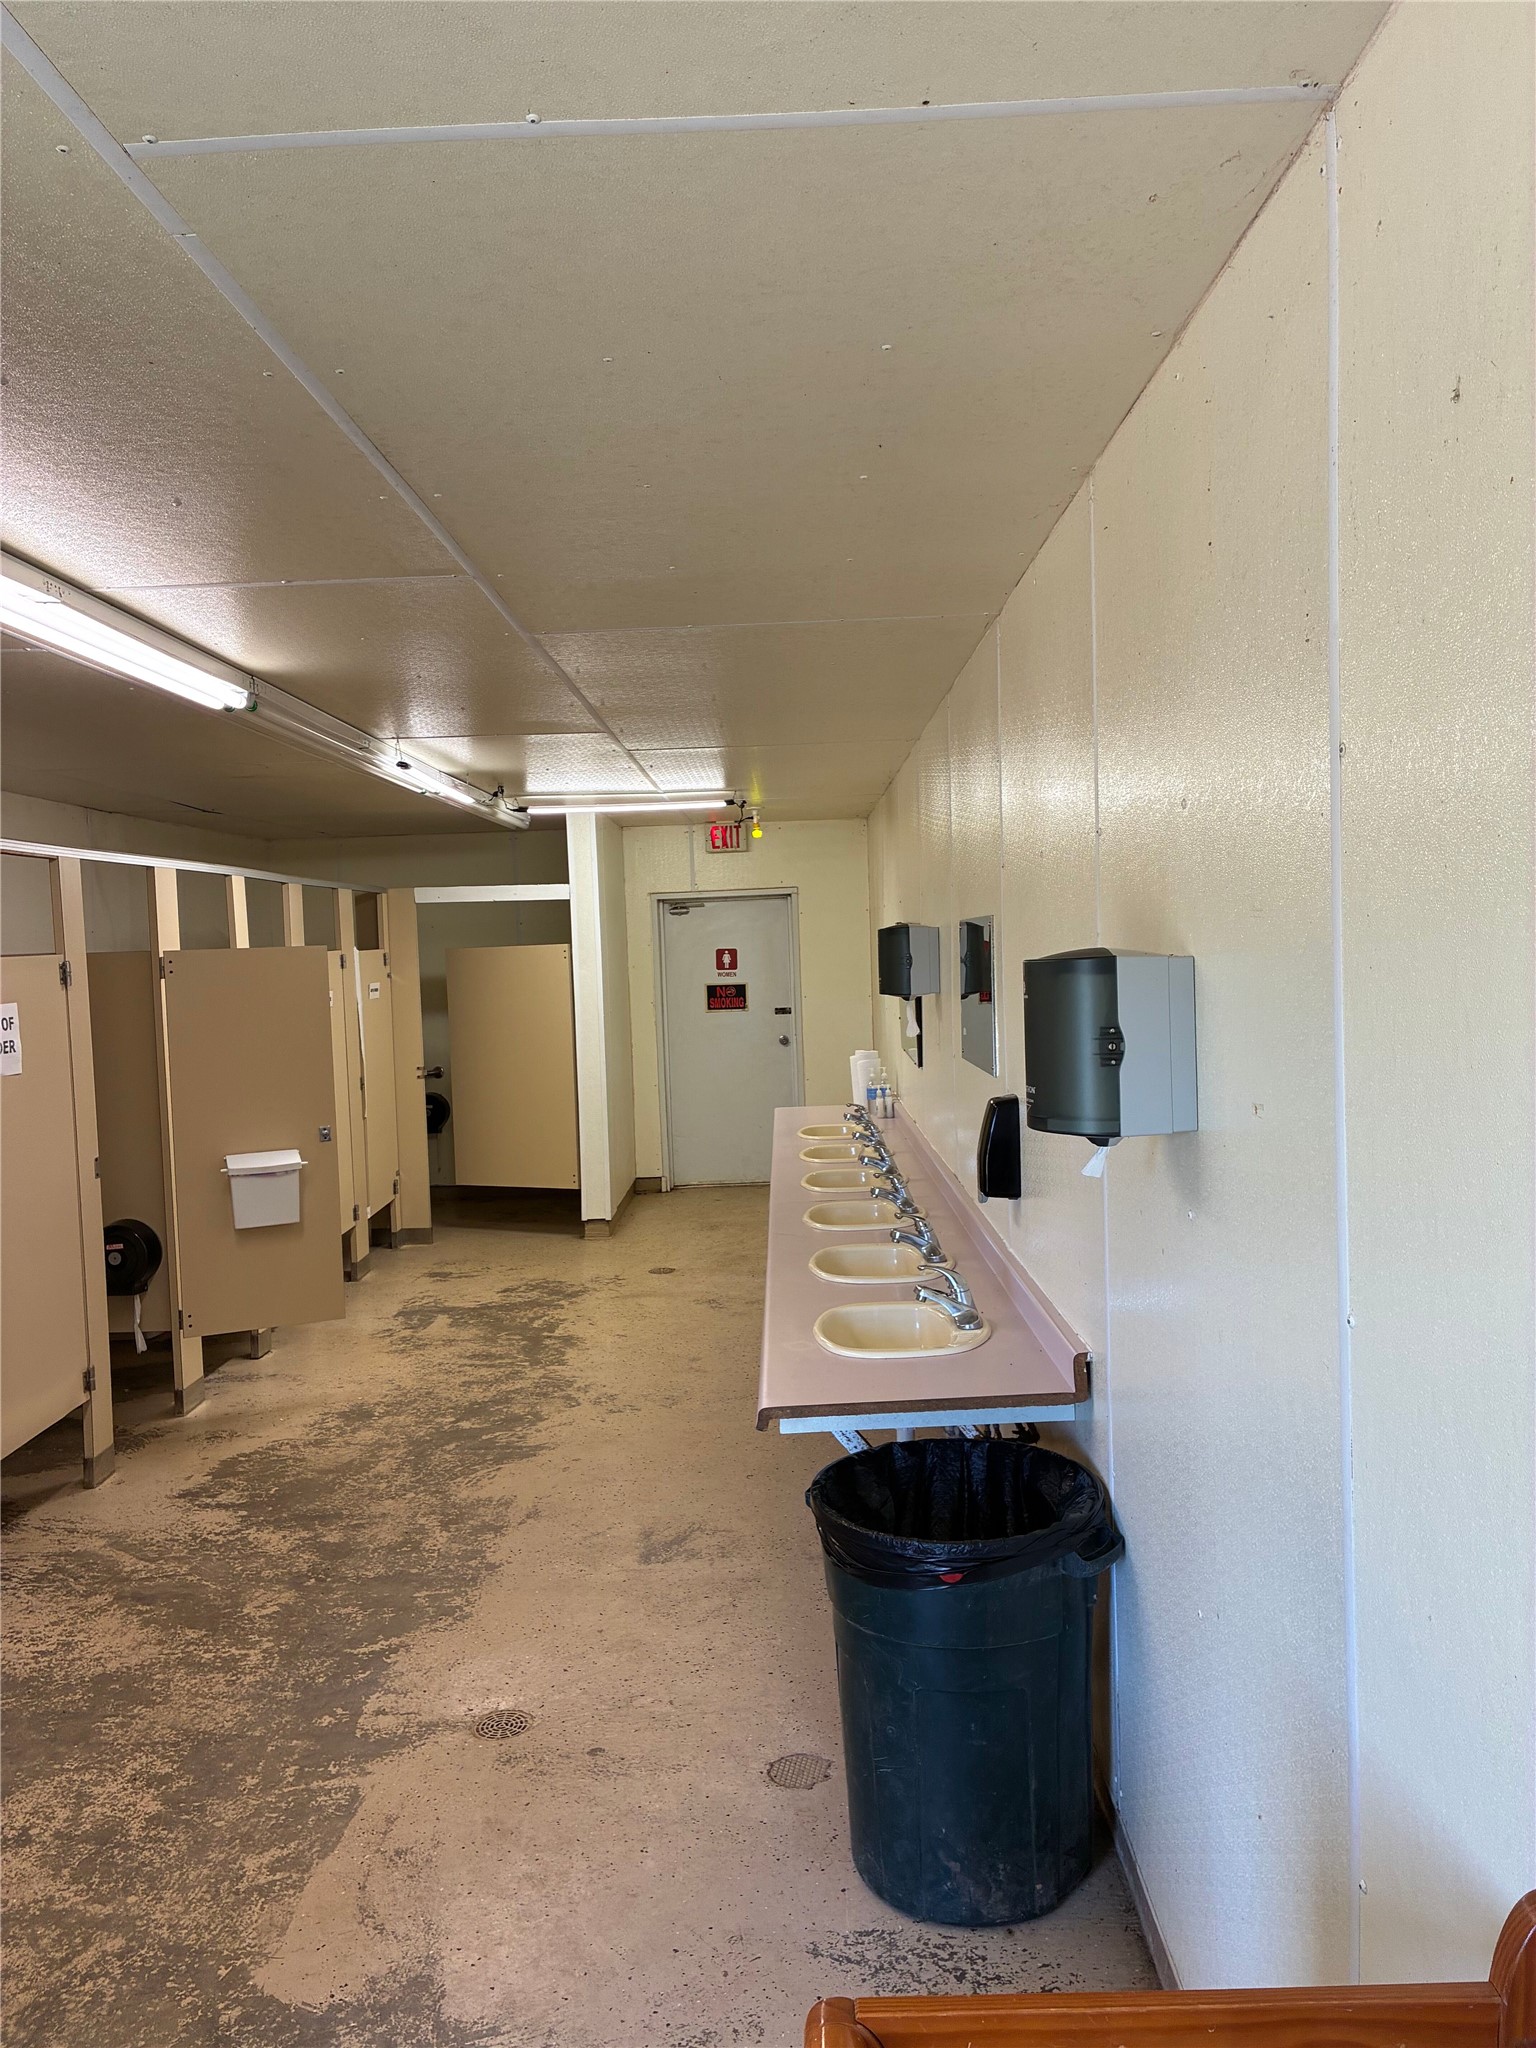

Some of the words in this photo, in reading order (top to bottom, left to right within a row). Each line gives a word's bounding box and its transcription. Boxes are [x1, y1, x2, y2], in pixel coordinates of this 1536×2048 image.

[711, 825, 741, 849] EXIT
[716, 986, 736, 997] NO
[709, 997, 744, 1008] SMOKING
[1, 1017, 14, 1031] OF
